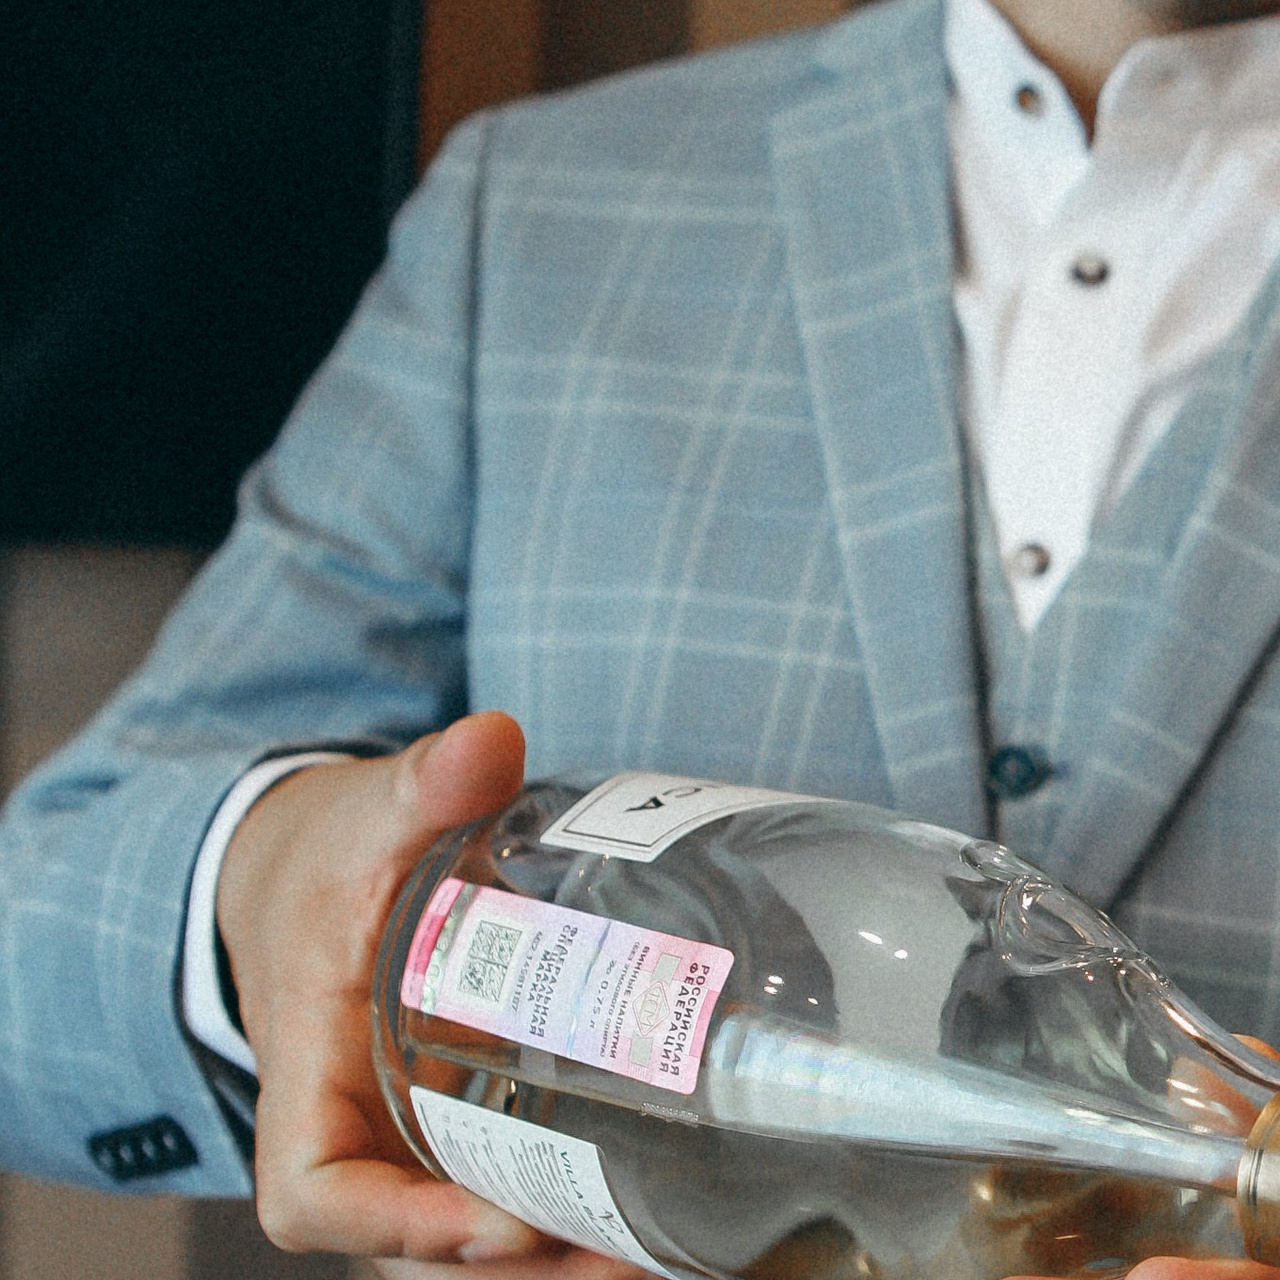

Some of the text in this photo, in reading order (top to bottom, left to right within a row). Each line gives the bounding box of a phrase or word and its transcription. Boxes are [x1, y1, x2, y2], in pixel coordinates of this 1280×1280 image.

[527, 949, 551, 1002] МАРКА
[529, 925, 571, 1035] СПЕЦИАЛЬНАЯ
[536, 927, 578, 1037] ФЕДЕРАЛЬНАЯ
[609, 945, 650, 1059] ВИННЫЕ НАПИТКИ
[659, 962, 698, 1073] ФЕДЕРАЦИЯ
[670, 964, 710, 1076] РОССИЙСКАЯ
[560, 1151, 583, 1199] VILLA
